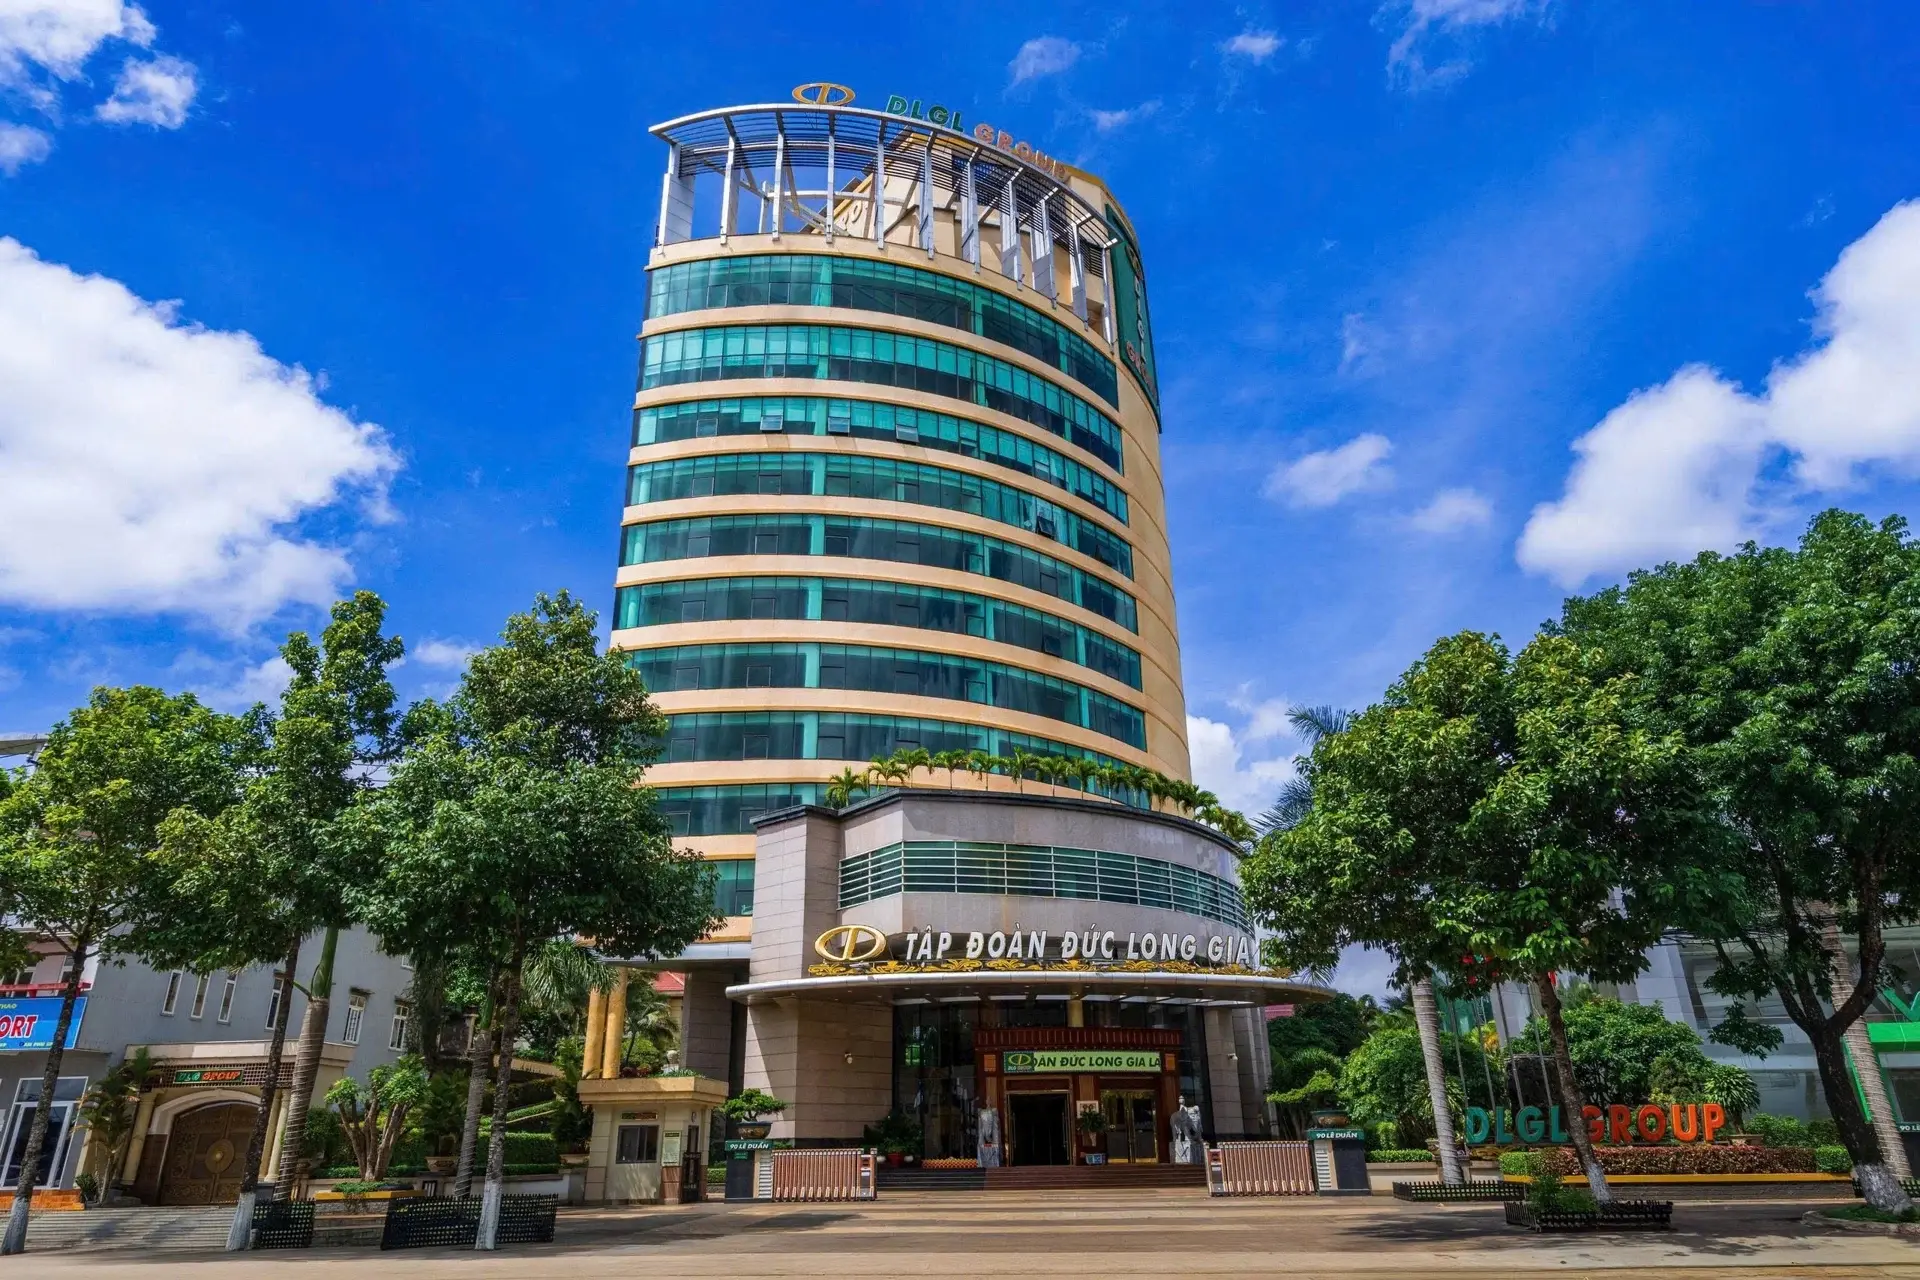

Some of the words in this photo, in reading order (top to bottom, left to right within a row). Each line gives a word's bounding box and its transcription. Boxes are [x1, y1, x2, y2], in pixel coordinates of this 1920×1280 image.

[885, 95, 964, 132] DLGL
[974, 123, 1067, 179] GROUP
[966, 922, 1047, 959] ĐOÀN
[1061, 924, 1115, 958] ĐỨC
[1126, 932, 1197, 960] LONG
[1207, 935, 1250, 964] GIA
[202, 1071, 240, 1081] GROUP
[1060, 1054, 1086, 1067] ĐỨC
[1089, 1056, 1122, 1067] LONG
[1126, 1057, 1145, 1067] GIA
[1465, 1104, 1568, 1144] DLGL
[1581, 1103, 1725, 1144] GROUP
